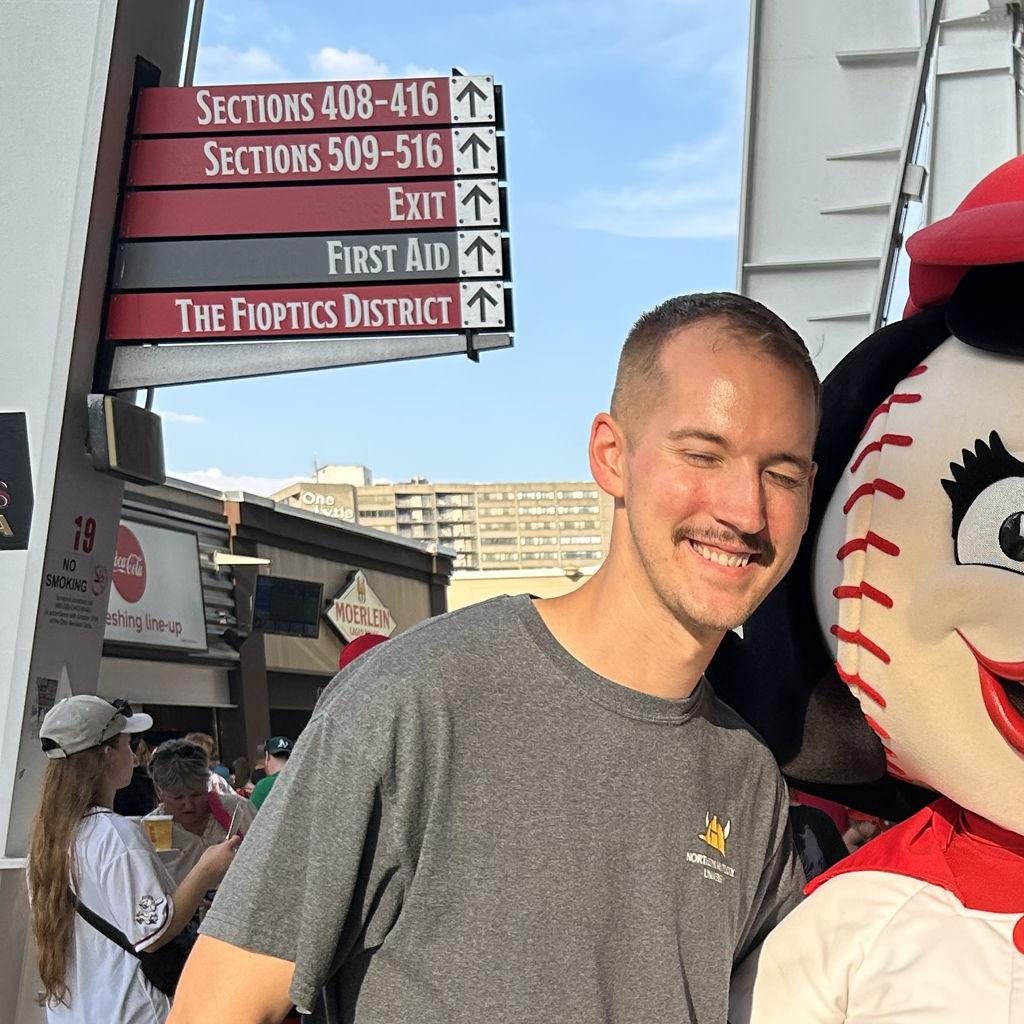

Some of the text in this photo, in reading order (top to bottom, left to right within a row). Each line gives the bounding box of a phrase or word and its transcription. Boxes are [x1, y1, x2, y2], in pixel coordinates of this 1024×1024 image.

[196, 80, 440, 126] SECTIONS 408-416
[204, 133, 445, 177] SECTIONS 509-516
[388, 186, 447, 221] EXIT
[327, 238, 451, 275] FIRST AID
[175, 294, 452, 332] THE FIOPTICS DISTRICT
[302, 491, 335, 505] One
[73, 515, 97, 554] 19
[62, 558, 77, 572] NO
[45, 574, 87, 593] SMOKING
[145, 613, 183, 638] line-up
[335, 602, 391, 629] MOERLEIN
